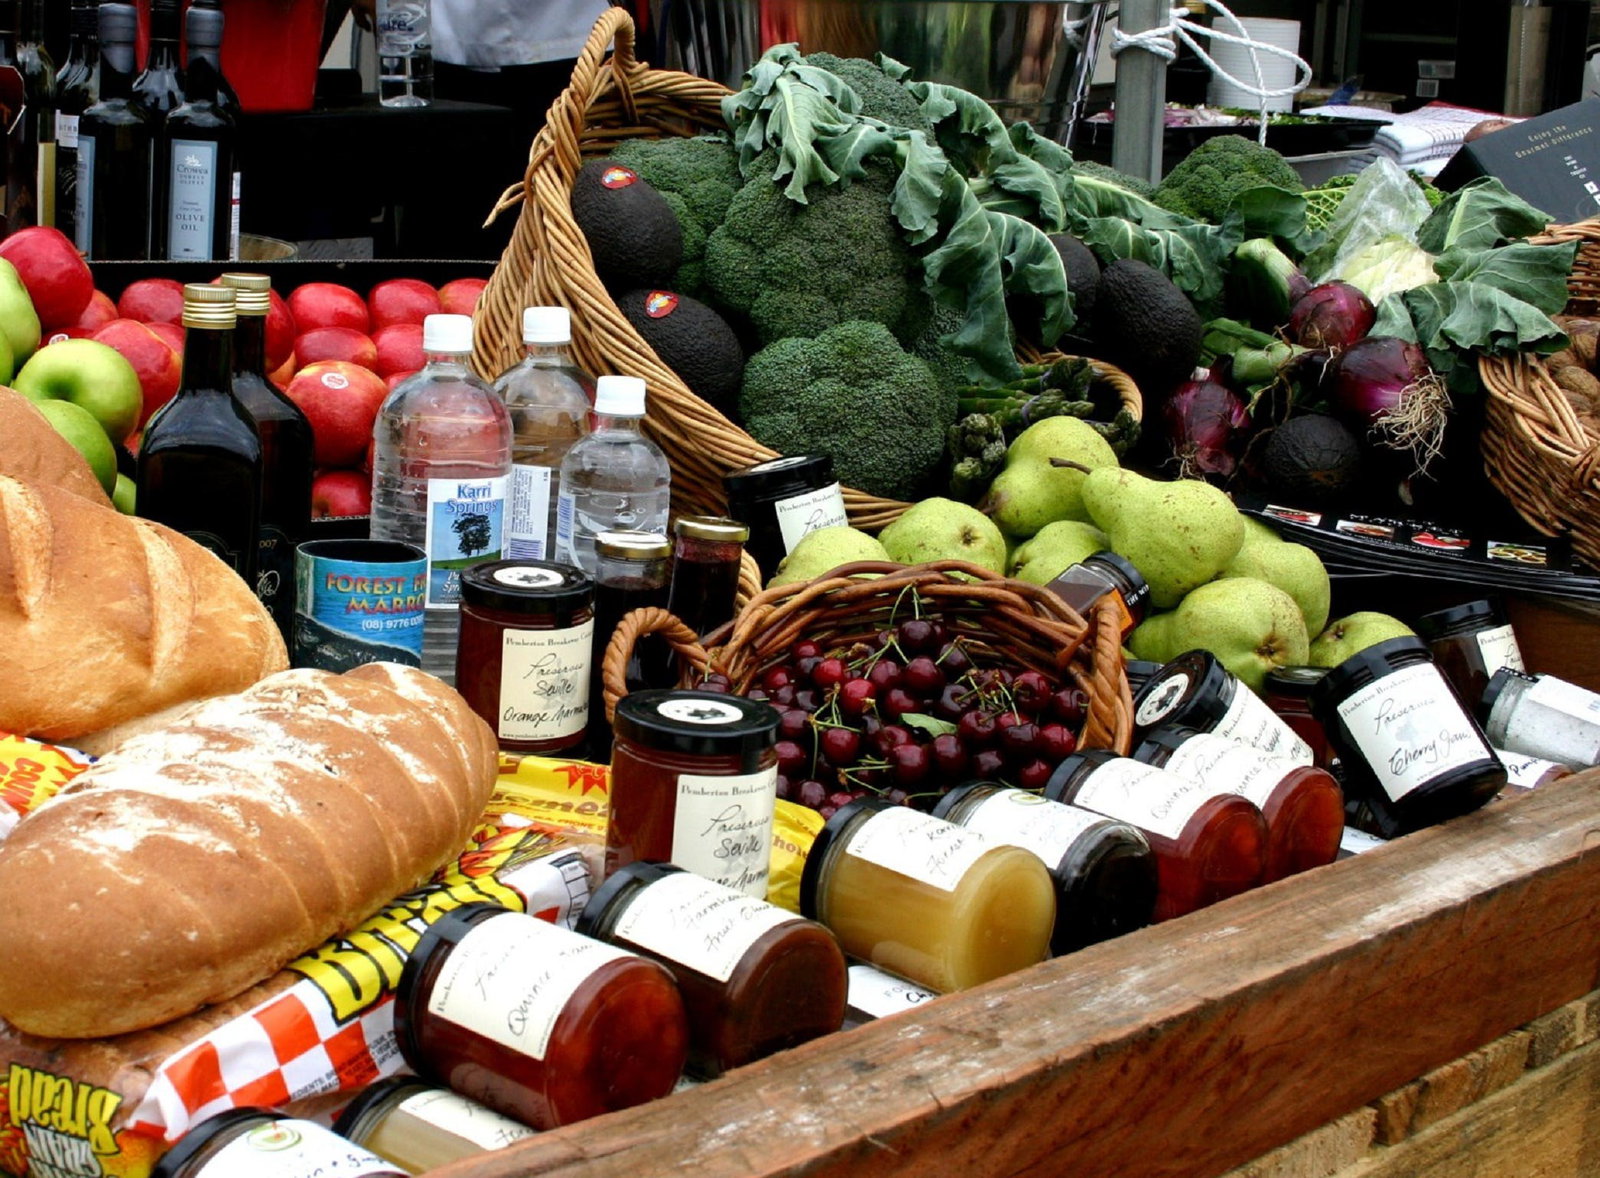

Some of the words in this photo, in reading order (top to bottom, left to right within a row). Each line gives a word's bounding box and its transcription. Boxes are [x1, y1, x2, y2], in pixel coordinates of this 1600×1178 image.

[175, 213, 206, 222] OLIVE
[457, 482, 492, 499] Karri
[446, 497, 498, 516] Springs
[326, 573, 408, 595] FOREST
[346, 594, 426, 615] MARRO
[361, 618, 384, 632] (08)
[384, 616, 409, 629] 9776
[503, 706, 550, 729] Orange
[1388, 740, 1438, 776] Cherry
[681, 784, 729, 796] Pemberton
[507, 970, 552, 1036] Quince
[8, 1062, 123, 1156] Bread
